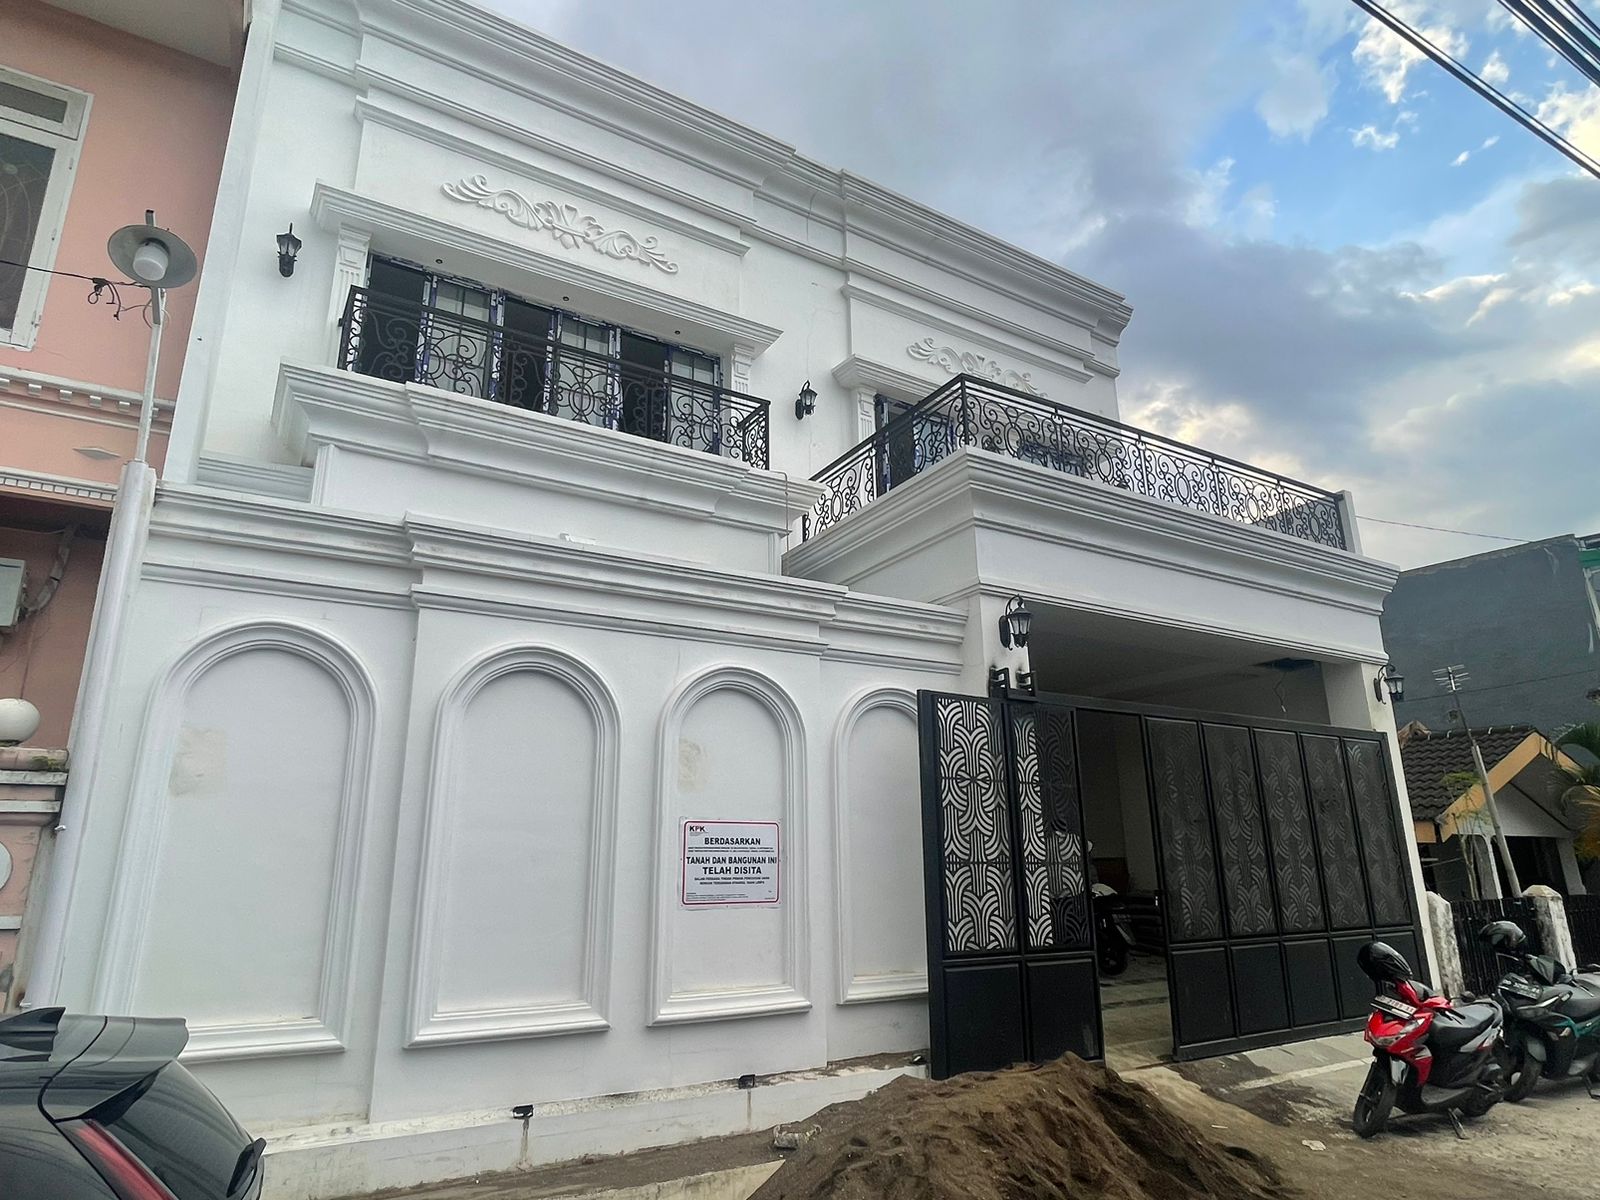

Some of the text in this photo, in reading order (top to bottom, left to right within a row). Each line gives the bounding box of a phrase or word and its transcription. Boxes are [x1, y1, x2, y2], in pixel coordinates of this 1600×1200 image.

[704, 837, 761, 845] BERDASARKAN
[686, 856, 777, 864] TANAH DAN BANGUNAN INI
[702, 866, 762, 875] TELAH DISITA
